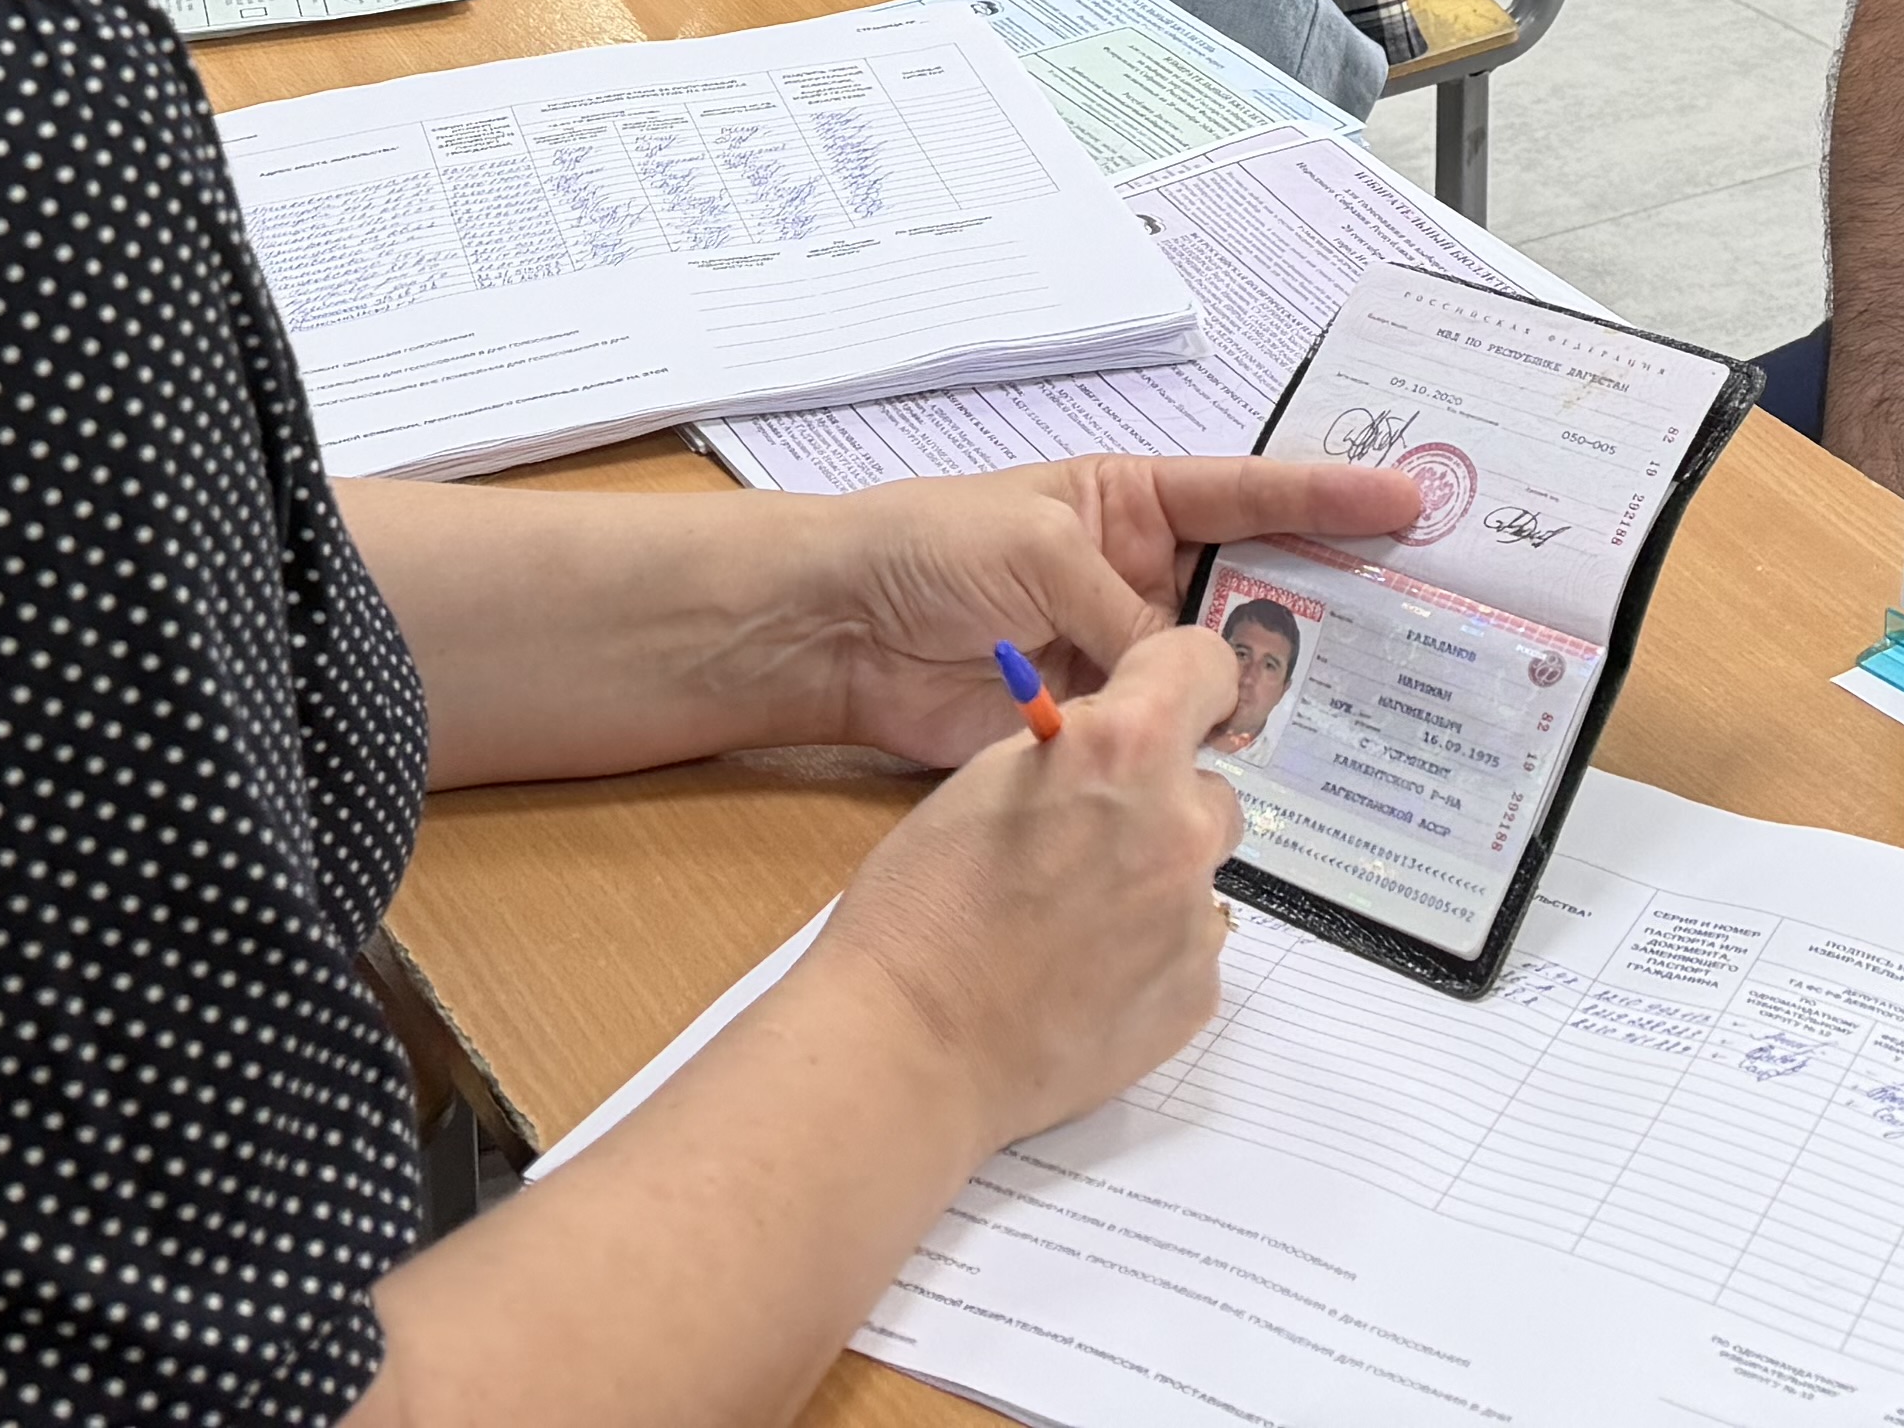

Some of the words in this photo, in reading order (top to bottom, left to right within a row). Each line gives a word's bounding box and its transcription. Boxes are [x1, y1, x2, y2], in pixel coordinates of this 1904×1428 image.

[1436, 327, 1461, 343] МВД
[1465, 335, 1482, 350] ПО
[1487, 343, 1563, 373] РЕСПУБЛИКЕ
[1566, 366, 1632, 393] ДАГЕСТАН
[1389, 376, 1463, 406] 09.10.2020
[1561, 430, 1617, 456] 050-005
[1662, 426, 1680, 445] 82
[1536, 711, 1554, 734] 82
[1422, 730, 1501, 768] 16.09.1975
[1653, 909, 1698, 927] СЕРИЯ
[1710, 922, 1761, 938] НОМЕР
[1644, 927, 1716, 950] ПАСПОРТА
[1630, 943, 1739, 973] ЗАМЕНЯЮЩЕГО
[1646, 956, 1711, 977] ПАСПОРТ
[1825, 939, 1893, 969] ПОДПИСЬ
[1626, 961, 1719, 990] ГРАЖДАНИНА
